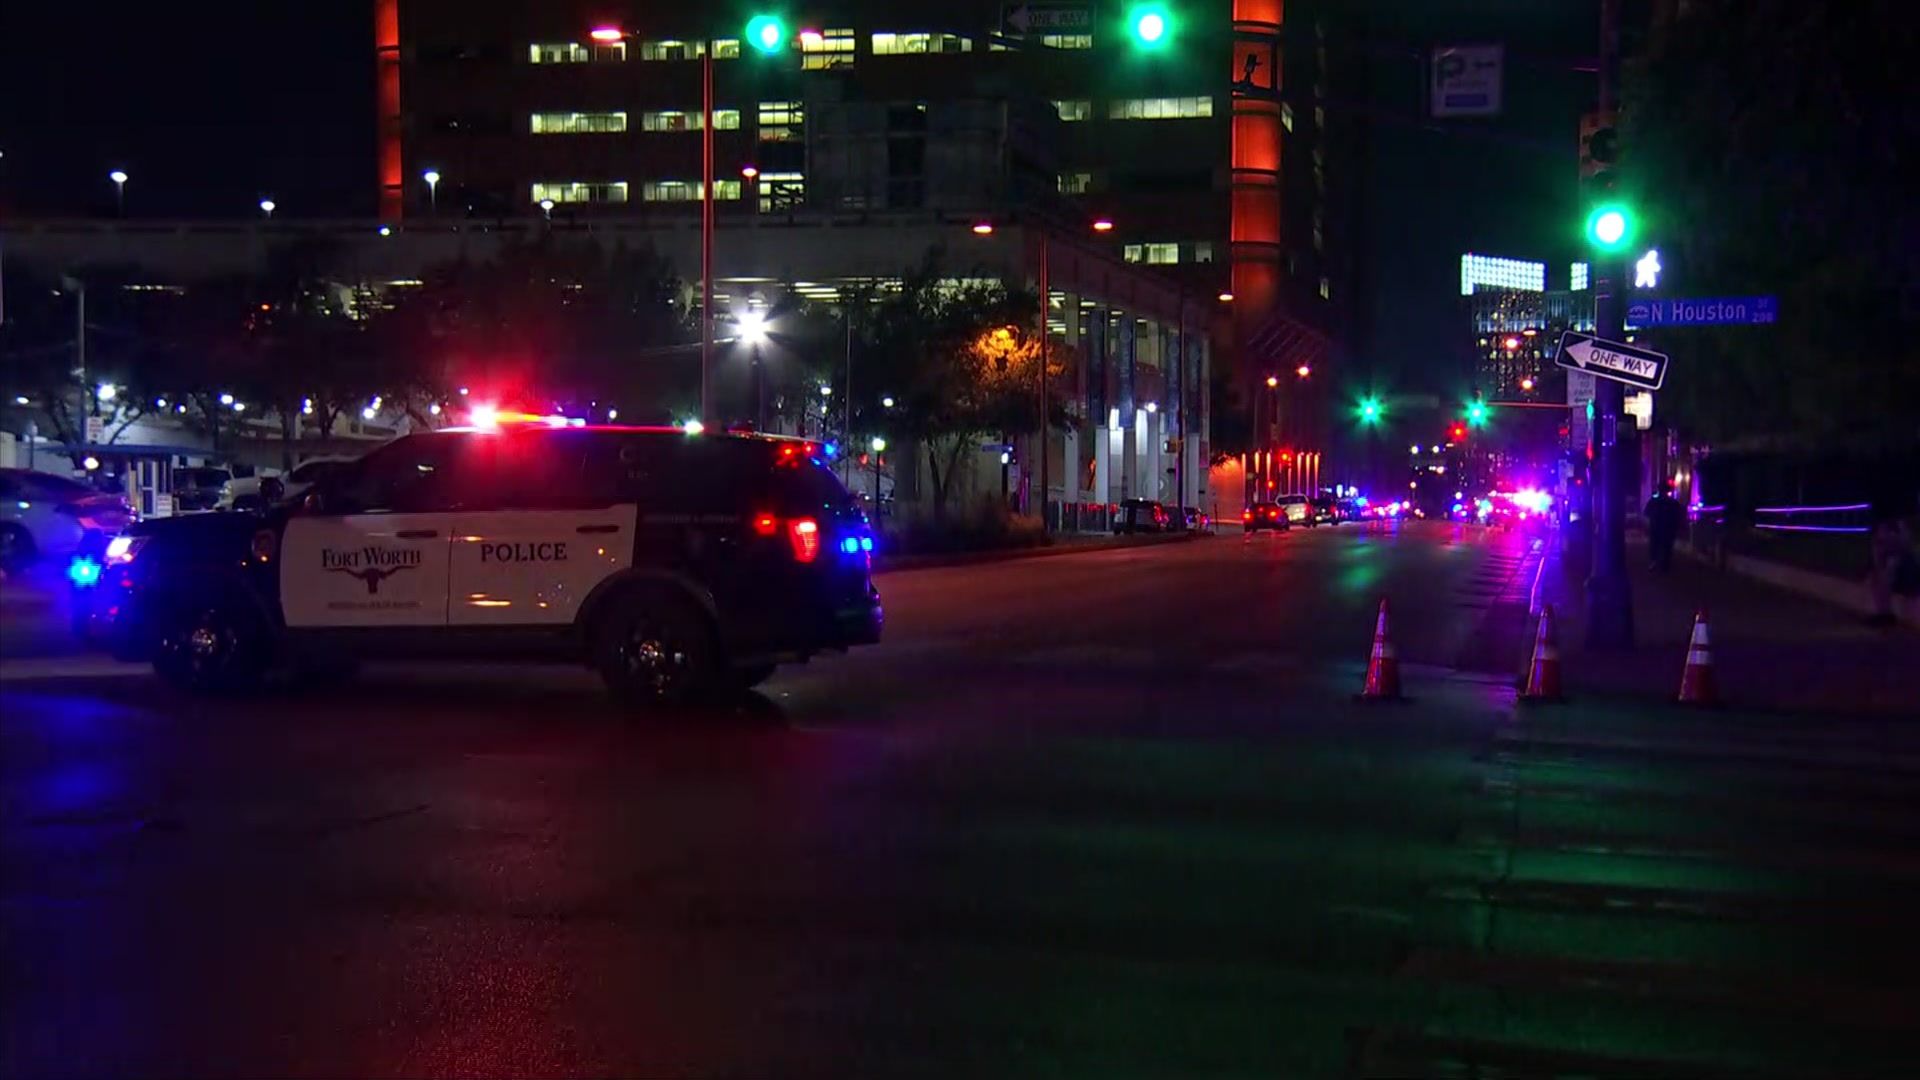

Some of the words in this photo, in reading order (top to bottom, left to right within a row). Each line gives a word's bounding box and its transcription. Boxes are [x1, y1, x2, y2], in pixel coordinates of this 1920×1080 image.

[1651, 303, 1663, 322] N
[1672, 302, 1746, 321] Houston
[1590, 349, 1619, 367] ONE
[1623, 357, 1653, 375] WAY
[322, 548, 360, 567] FORT
[363, 547, 420, 565] WORTH
[481, 543, 567, 562] POLICE
